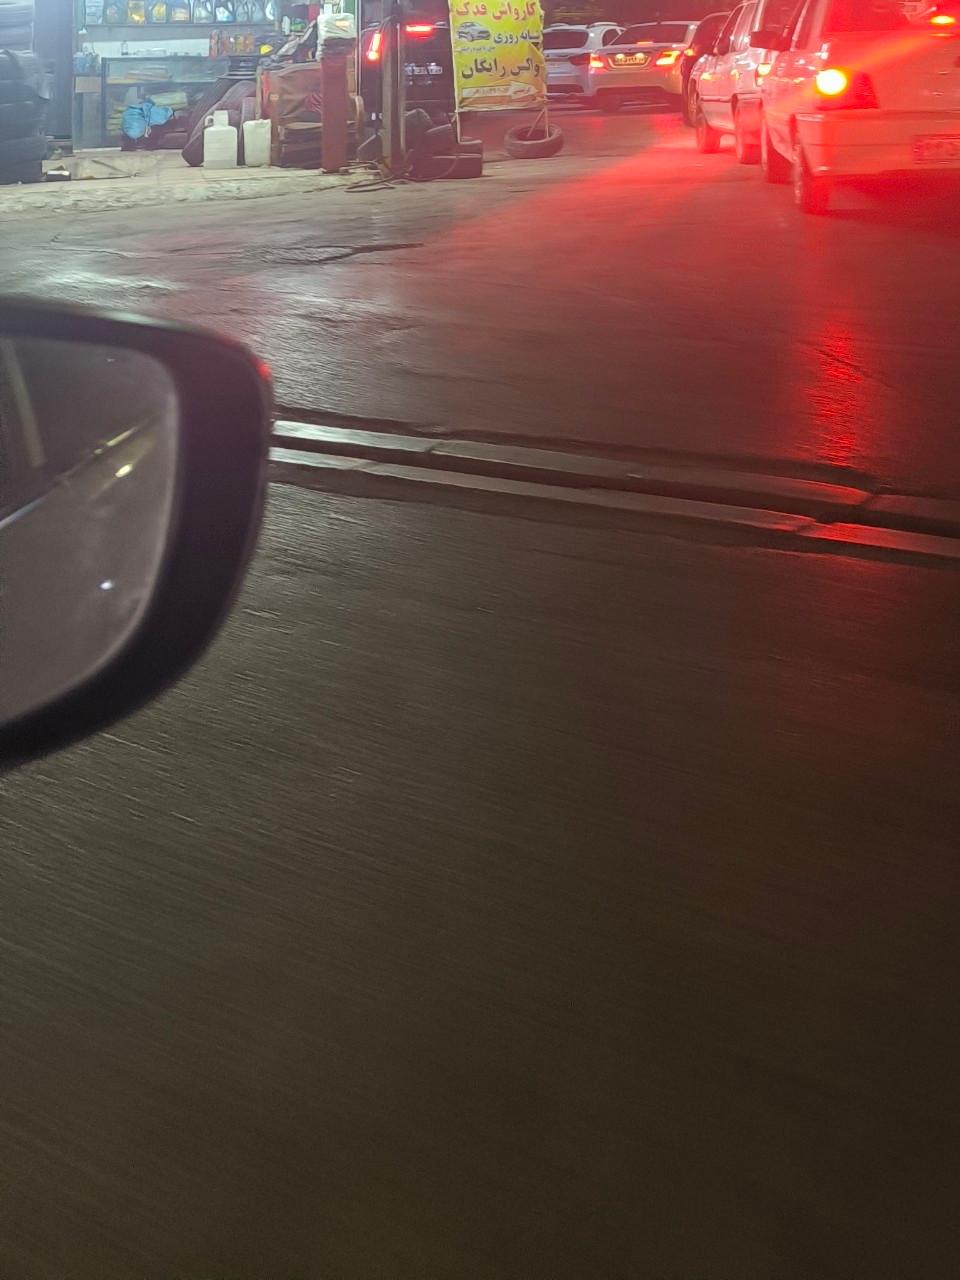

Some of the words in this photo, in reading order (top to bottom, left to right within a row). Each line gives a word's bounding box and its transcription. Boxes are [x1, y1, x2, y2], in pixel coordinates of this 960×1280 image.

[456, 1, 488, 18] فدک
[492, 0, 536, 22] کارواش
[493, 30, 519, 44] روزی
[461, 57, 506, 79] رایگان
